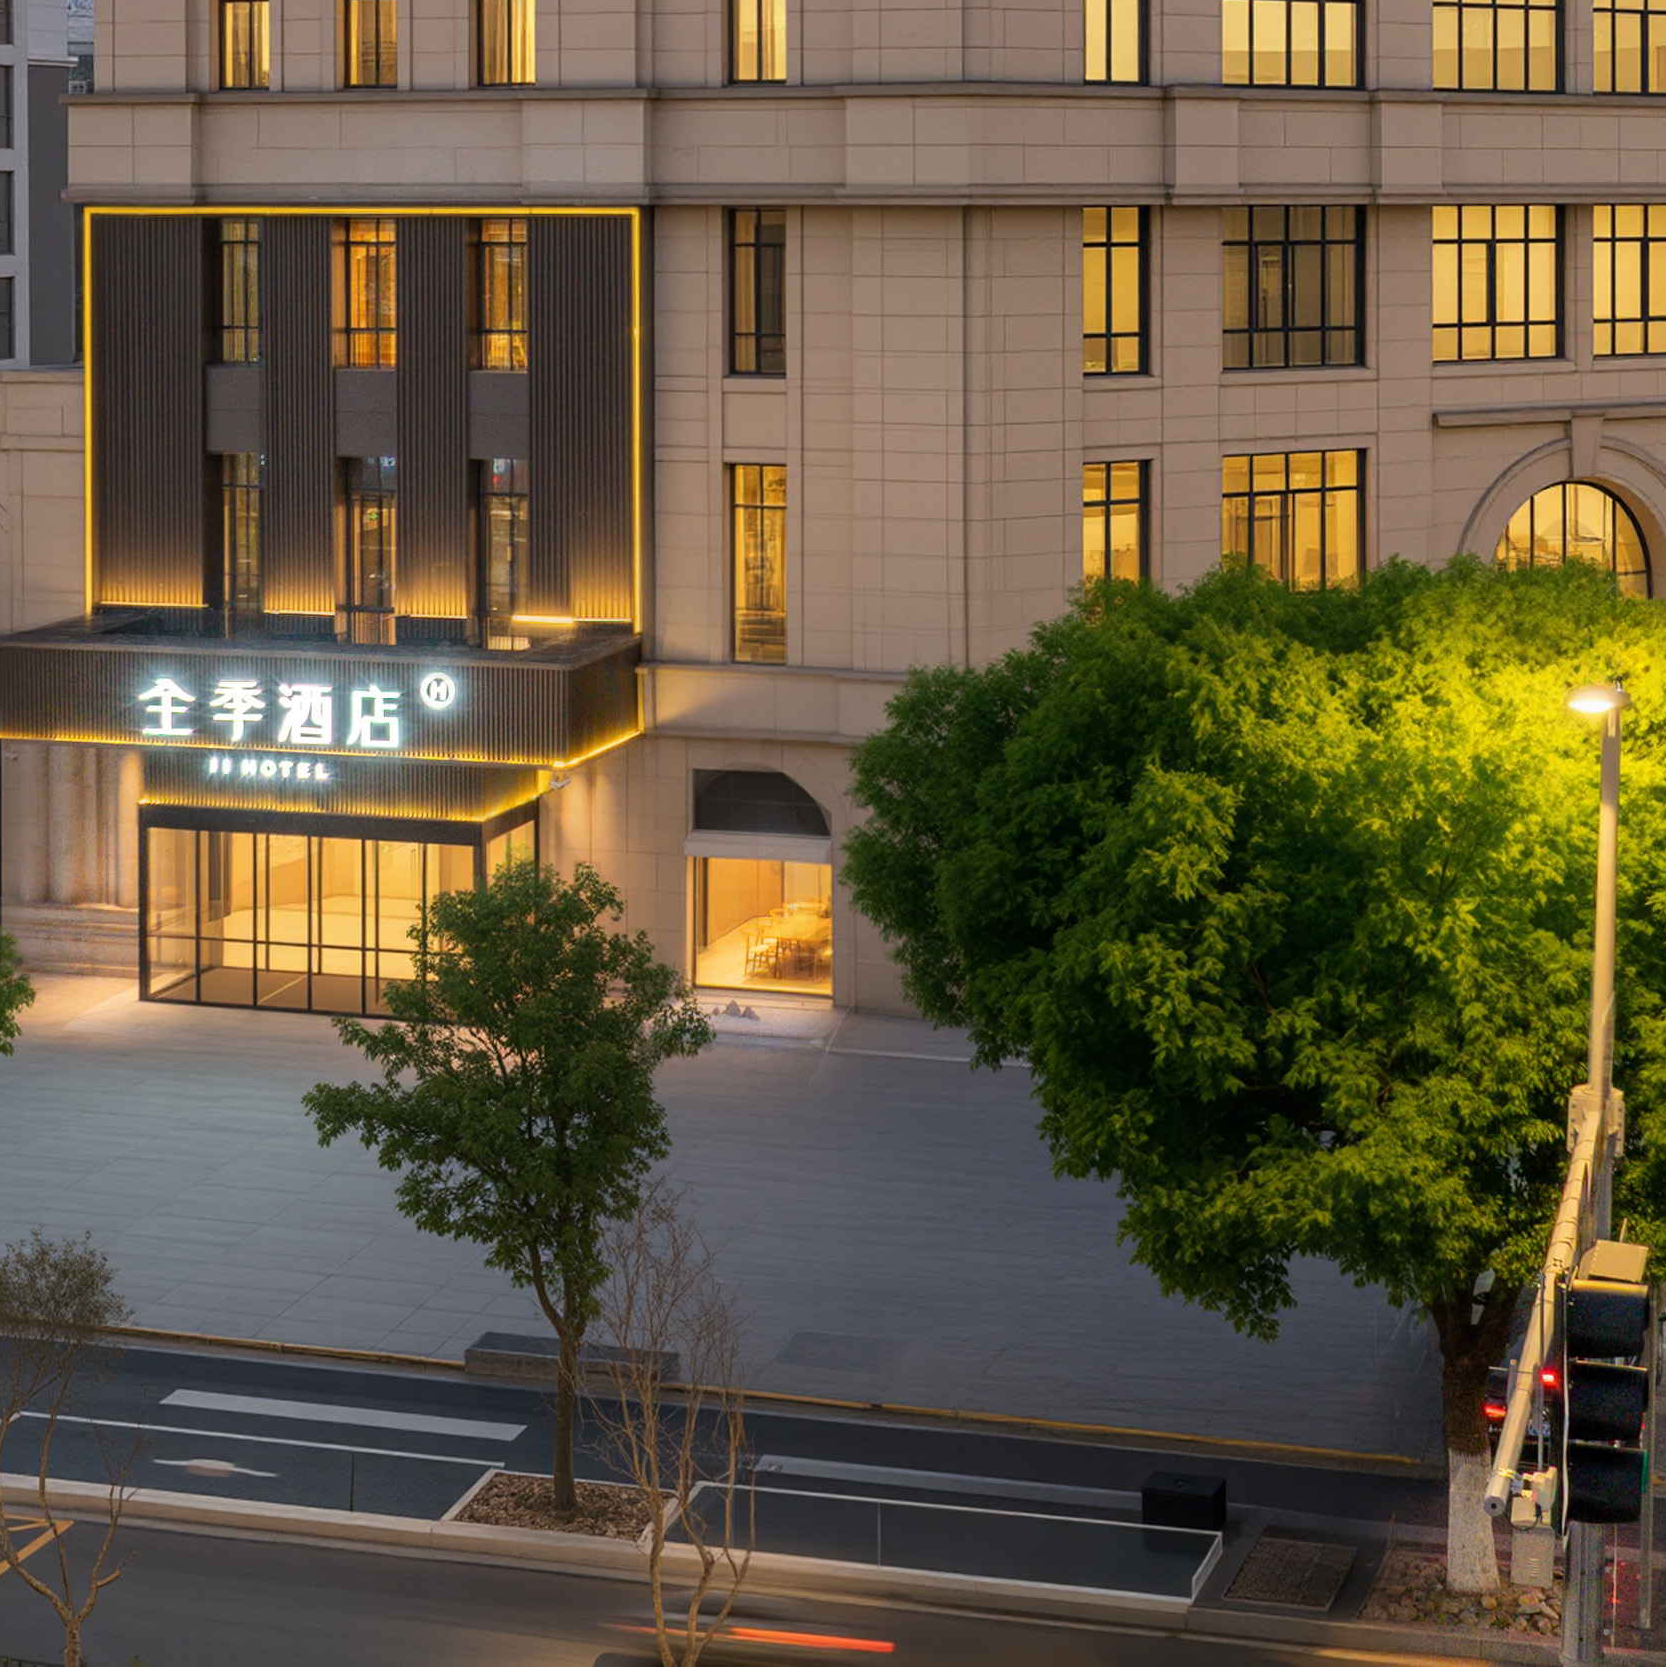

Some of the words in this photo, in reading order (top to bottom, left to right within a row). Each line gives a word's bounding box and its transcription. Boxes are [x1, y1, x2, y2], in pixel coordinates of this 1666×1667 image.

[138, 678, 401, 748] 全季酒店
[240, 758, 329, 780] HOTEL
